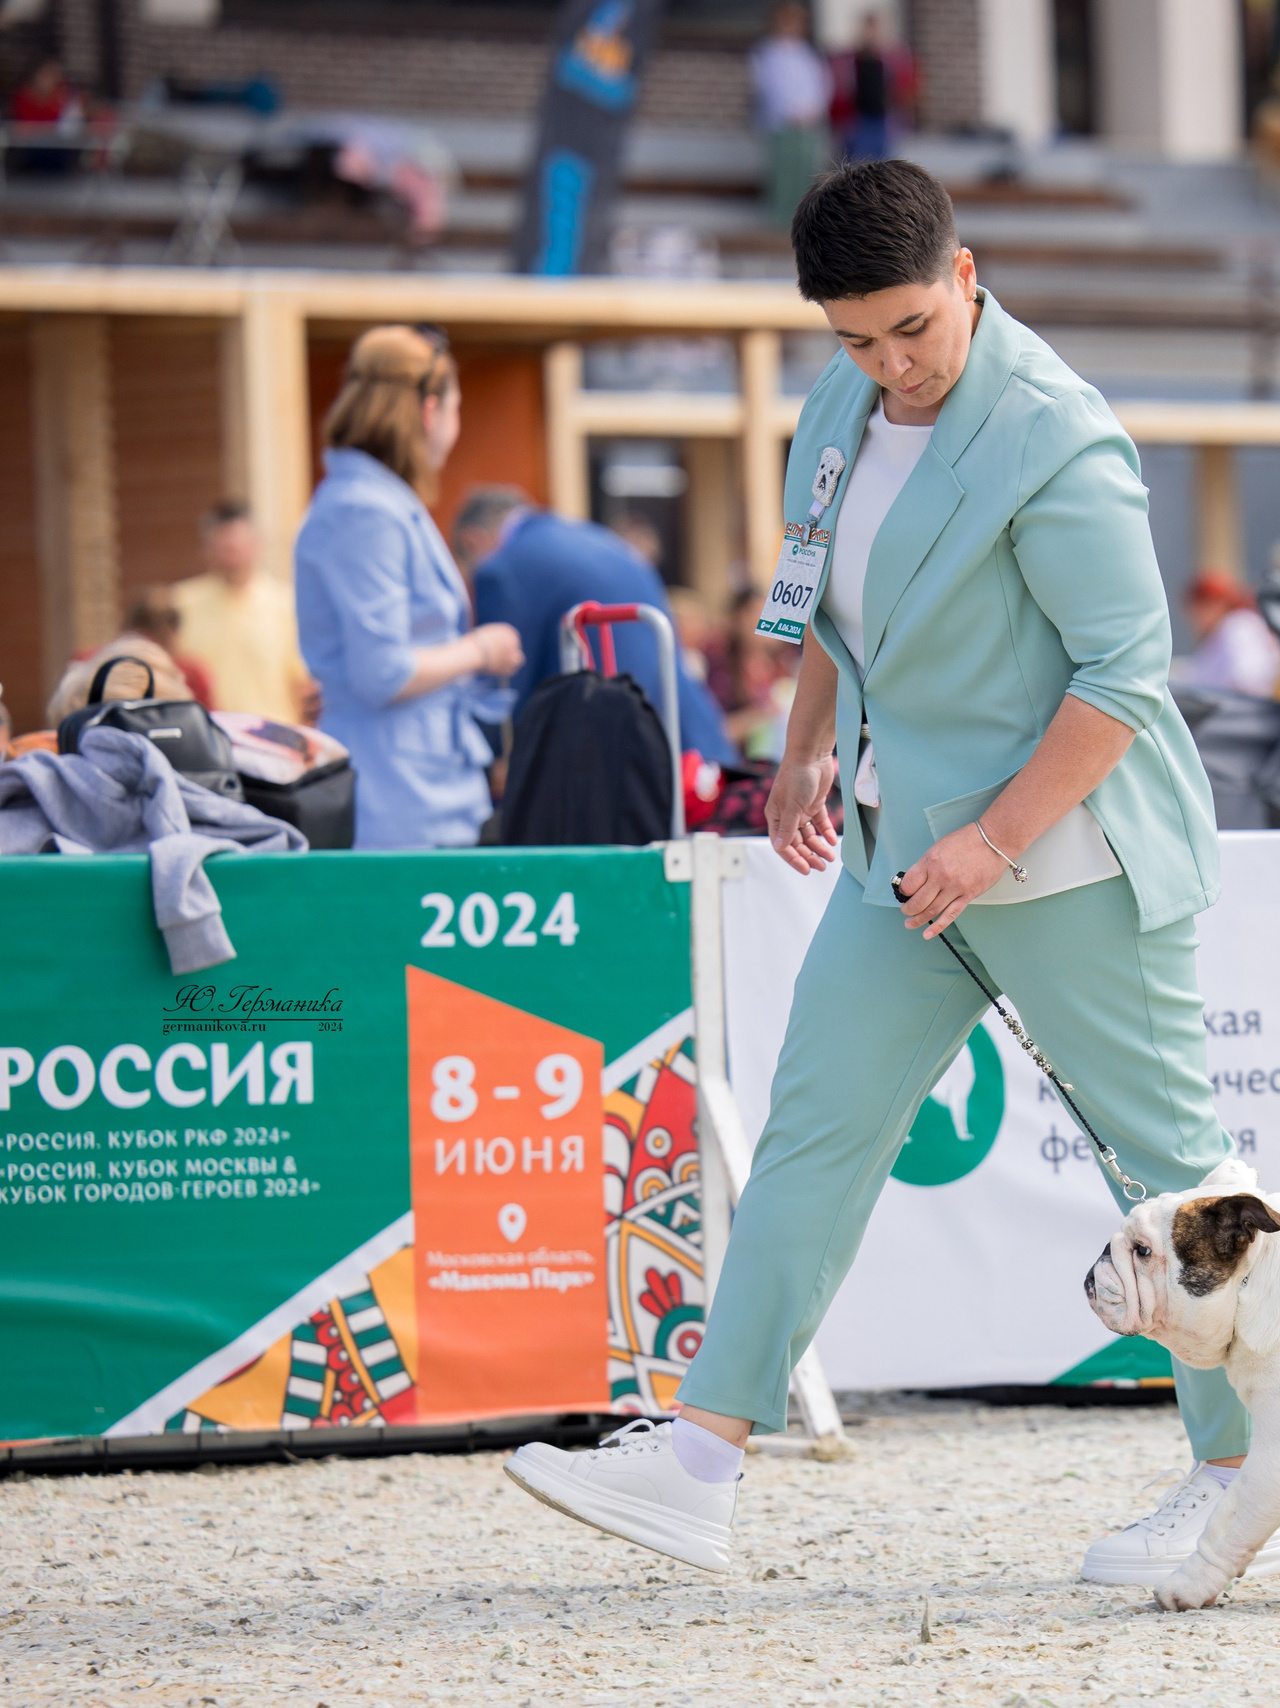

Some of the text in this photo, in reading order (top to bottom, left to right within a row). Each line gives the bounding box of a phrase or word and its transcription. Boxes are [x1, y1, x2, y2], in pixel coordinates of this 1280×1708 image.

[772, 580, 813, 609] 0607
[777, 622, 802, 635] 8.06.2024
[420, 891, 580, 948] 2024
[0, 1041, 313, 1111] РОССИЯ
[108, 1129, 178, 1149] КУБОК
[184, 1128, 228, 1147] РКФ
[233, 1126, 290, 1146] 2024»
[108, 1158, 178, 1179] КУБОК
[184, 1156, 277, 1177] МОСКВЫ
[282, 1155, 298, 1175] &
[435, 1135, 584, 1175] ИЮНЯ
[0, 1183, 67, 1204] КУБОК
[263, 1177, 321, 1198] 2024»
